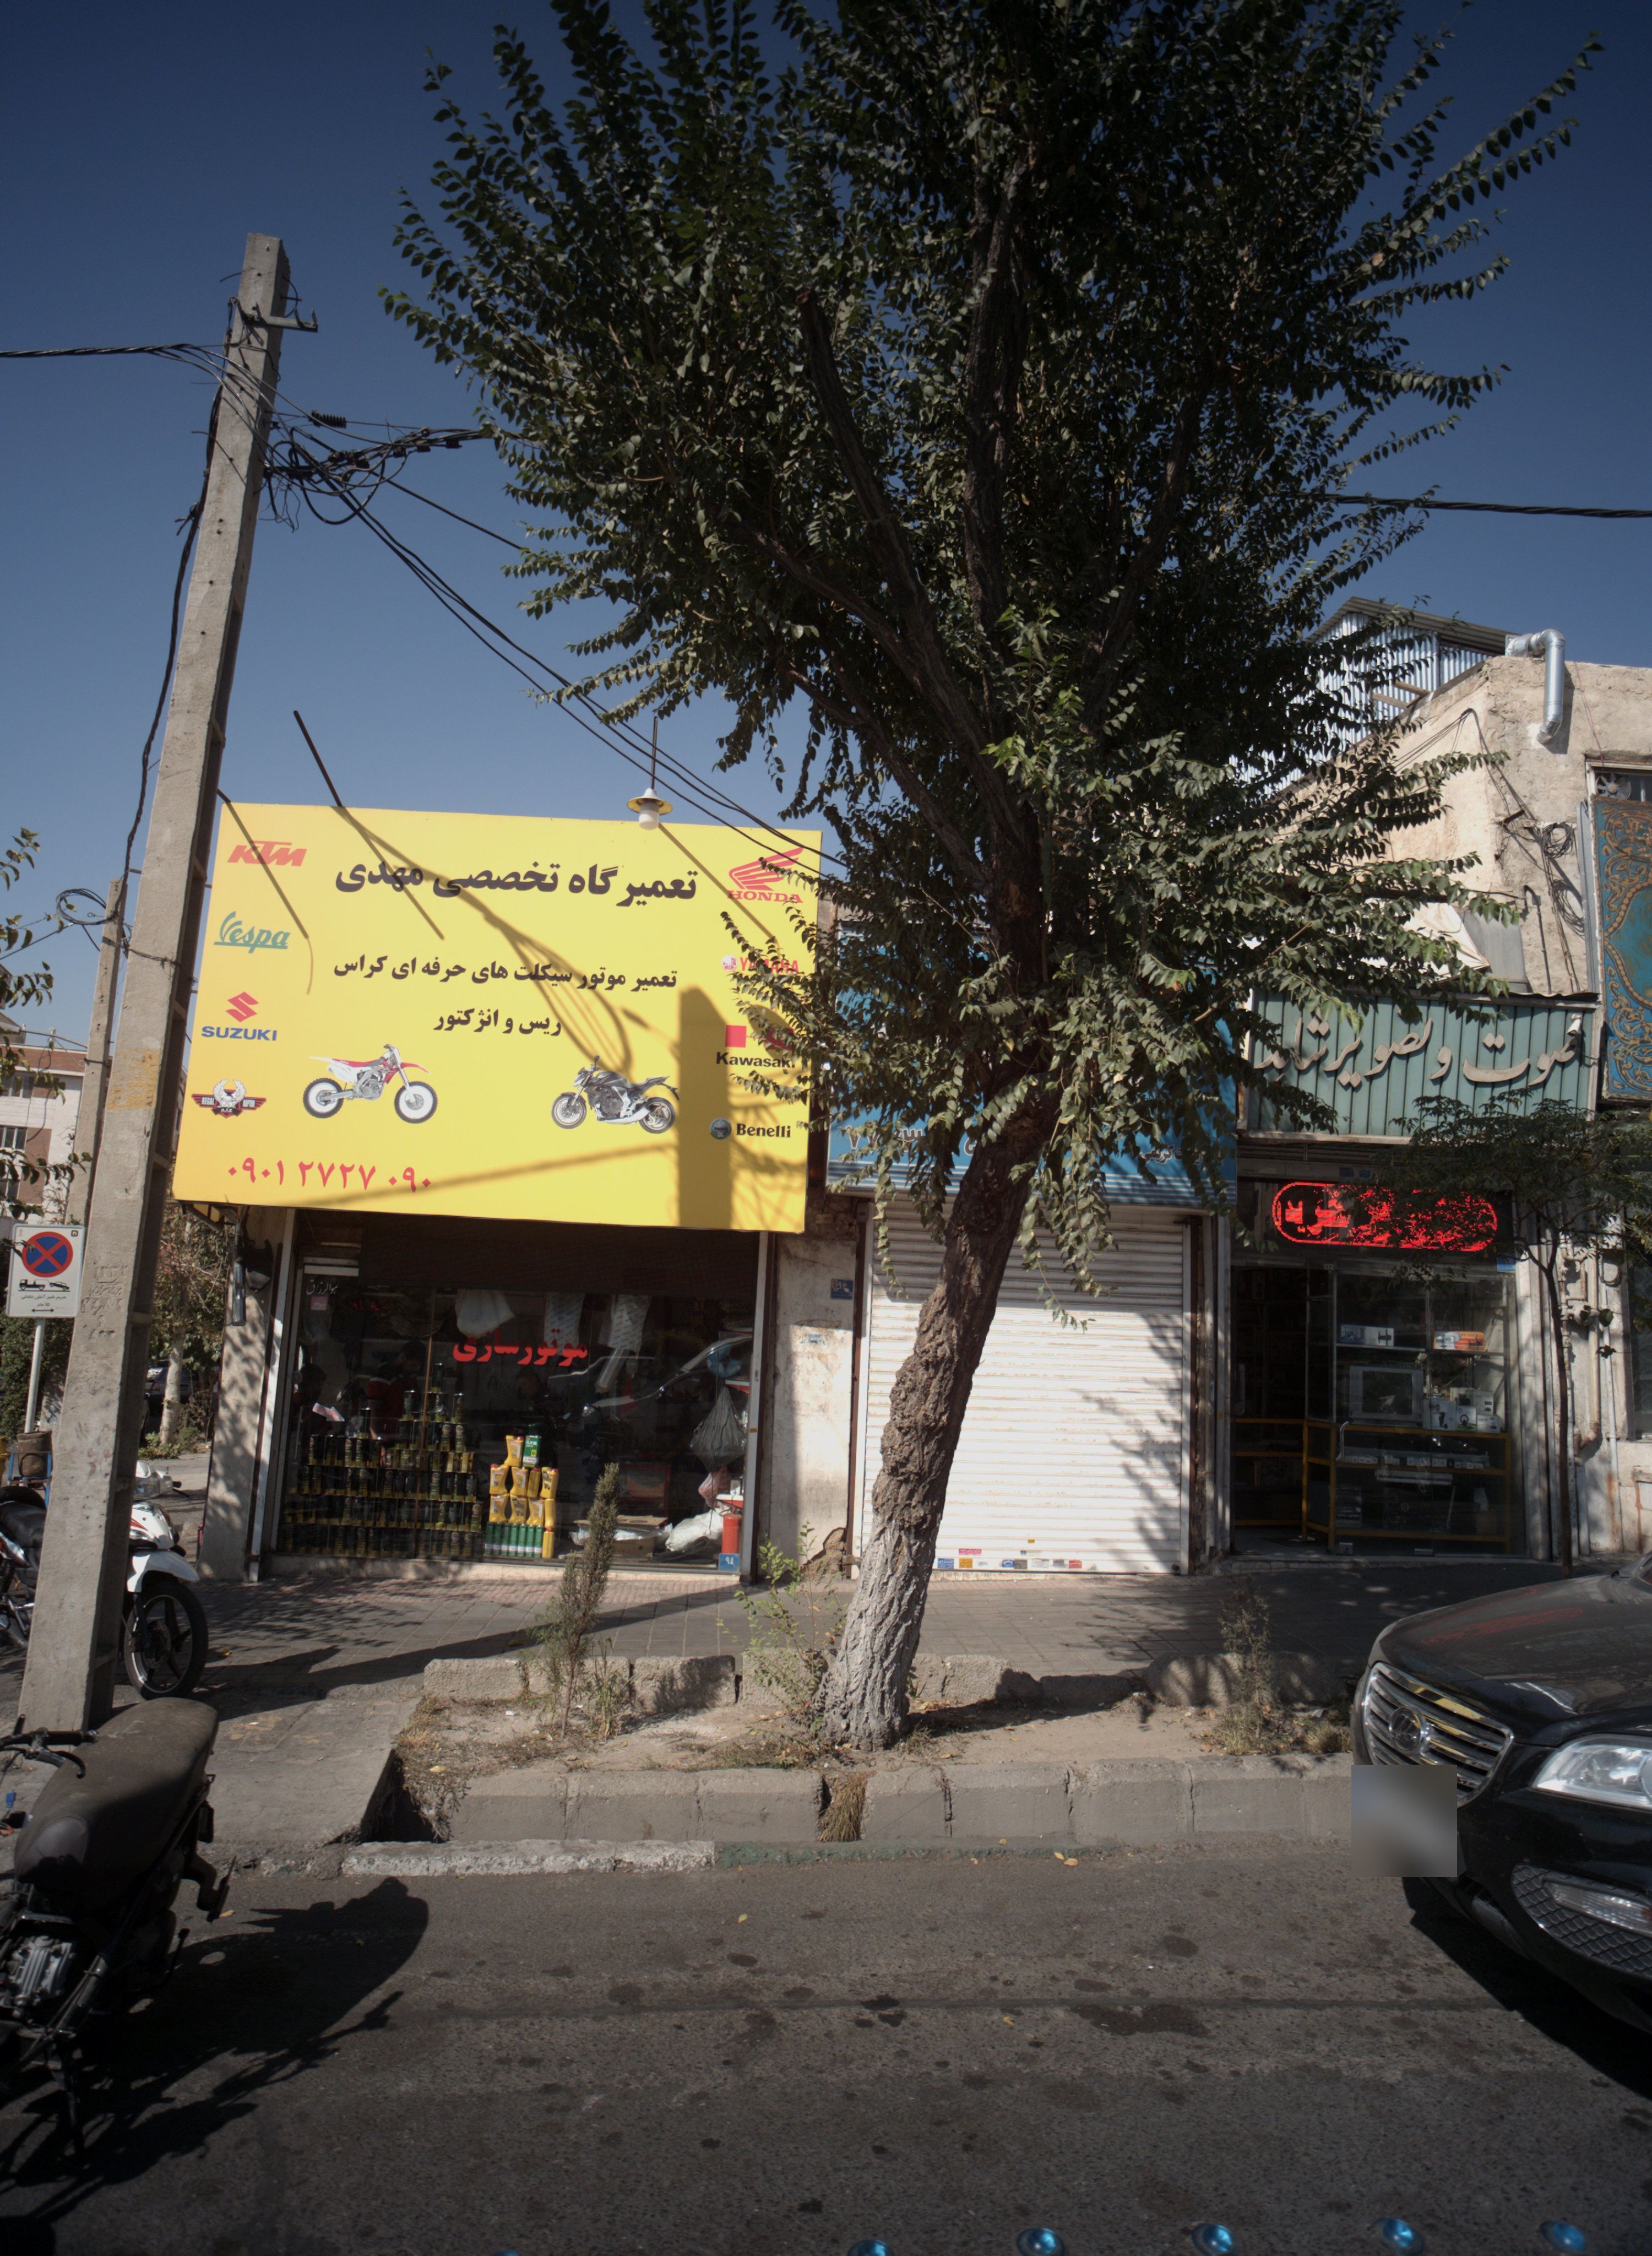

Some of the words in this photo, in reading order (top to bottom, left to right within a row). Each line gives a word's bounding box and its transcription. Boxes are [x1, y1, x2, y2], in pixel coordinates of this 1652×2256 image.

[227, 840, 307, 867] KTM
[335, 860, 423, 893] مهدی
[433, 861, 561, 898] تخصصی
[727, 890, 803, 904] HONDA
[214, 911, 291, 954] Vespa
[334, 953, 388, 979] کراس
[392, 957, 417, 980] ای
[421, 956, 466, 983] حرفه
[471, 961, 508, 984] های
[630, 969, 678, 993] تعمیر
[201, 1026, 278, 1041] SUZUKI
[502, 1017, 514, 1034] و
[518, 1017, 562, 1037] ریس
[1430, 1046, 1452, 1080] و
[736, 1123, 791, 1138] Benelli
